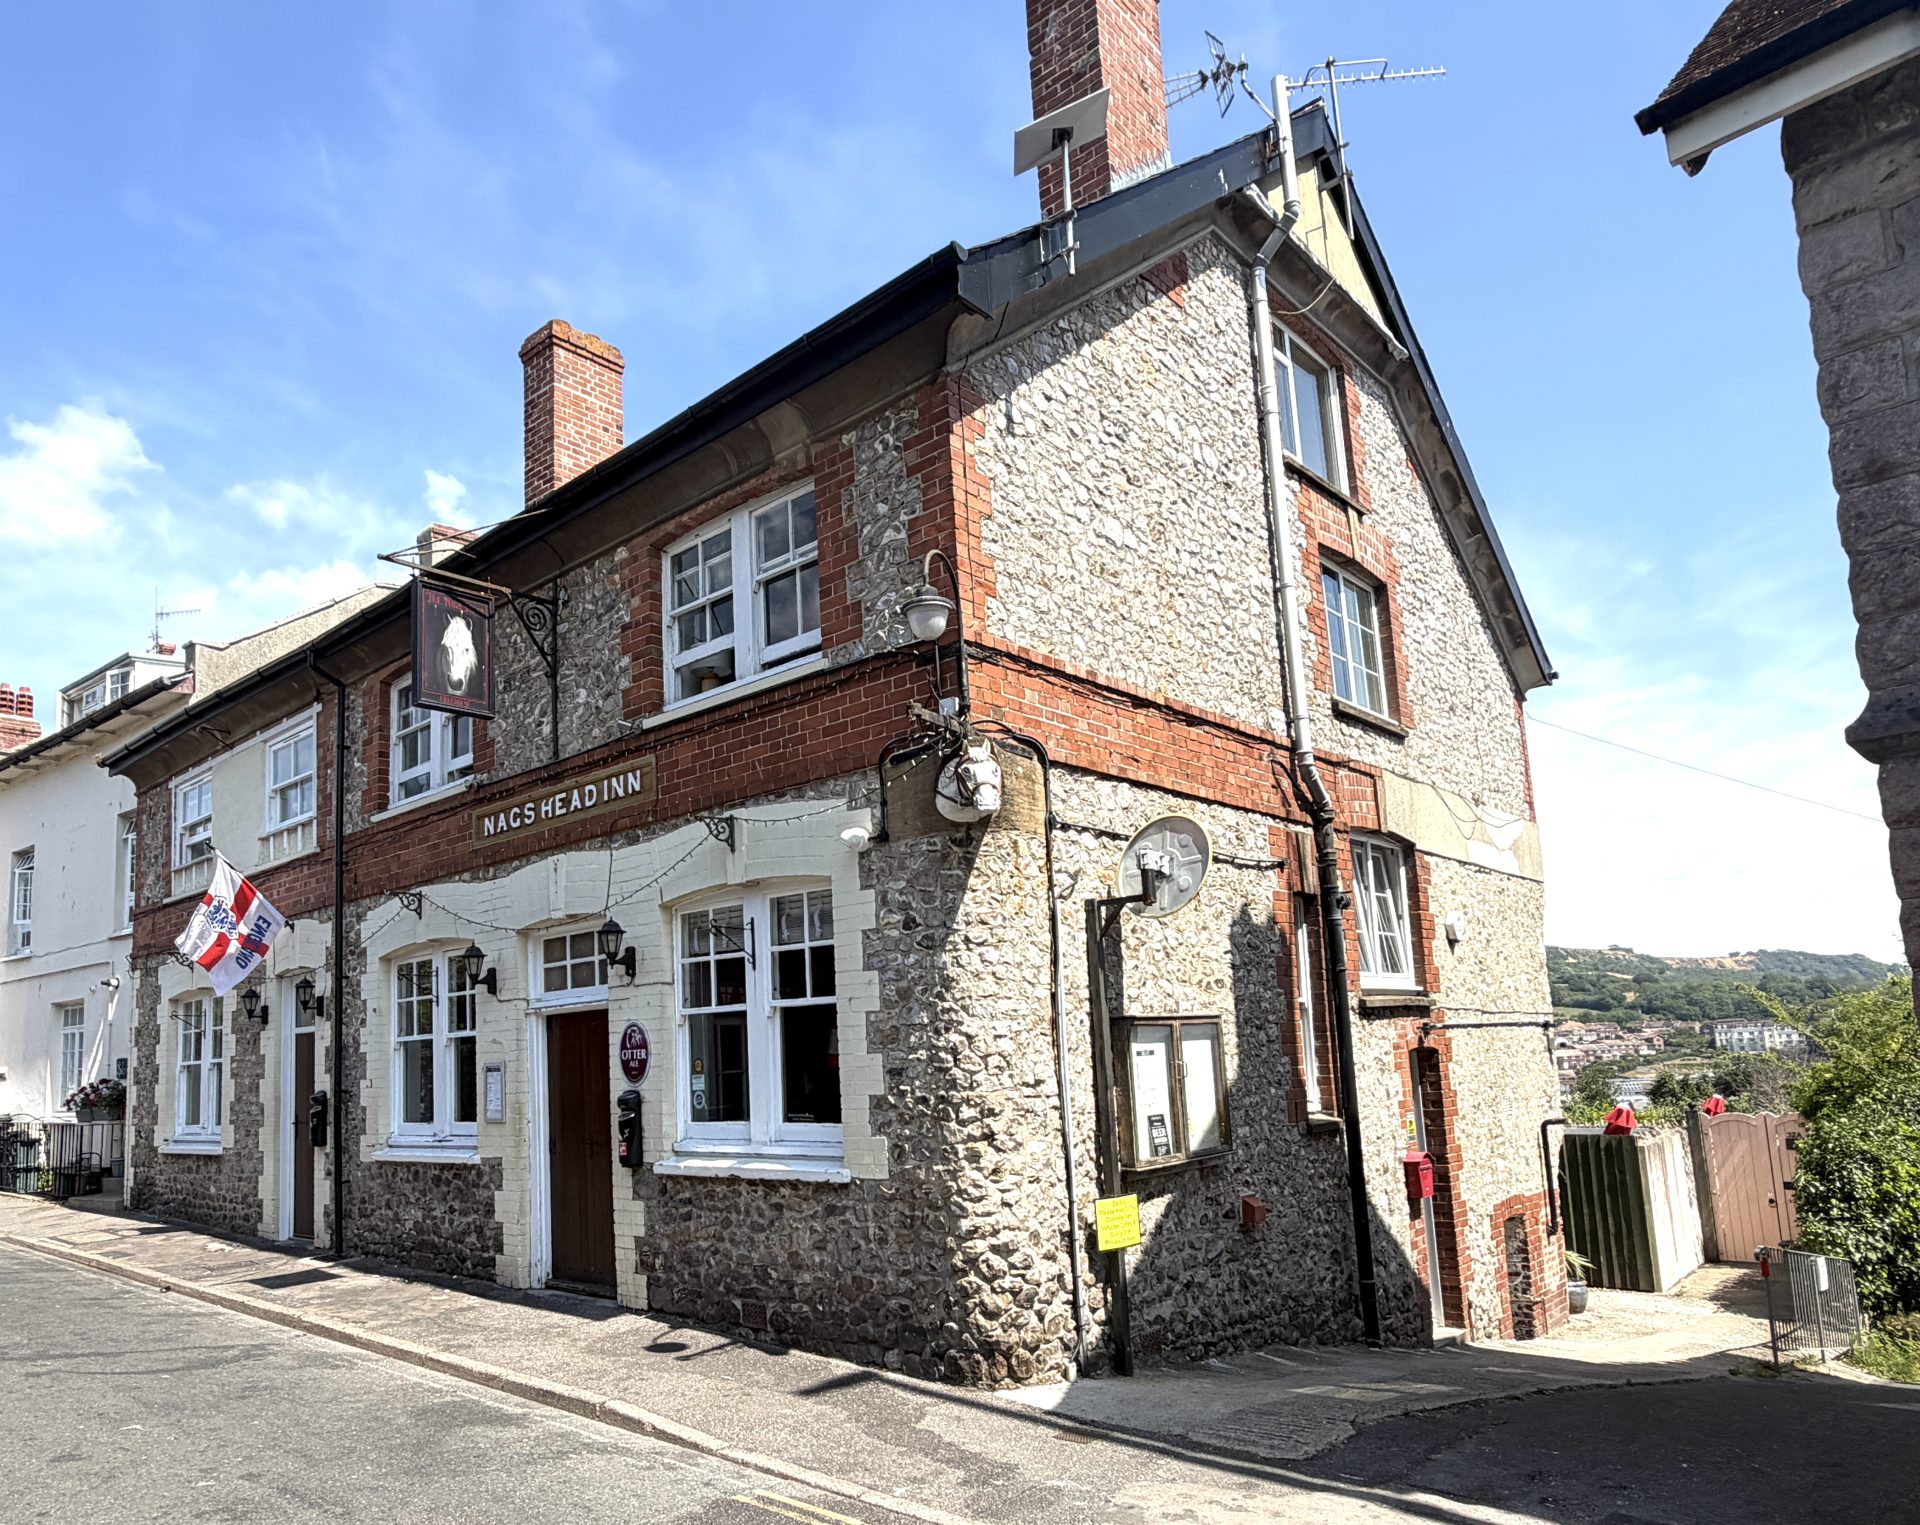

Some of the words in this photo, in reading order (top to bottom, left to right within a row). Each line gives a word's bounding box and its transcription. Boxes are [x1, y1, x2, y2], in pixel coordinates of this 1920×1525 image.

[484, 802, 536, 837] NAGS
[541, 784, 597, 819] HEAD
[603, 769, 641, 801] INN
[621, 1048, 647, 1060] OTTER
[629, 1060, 640, 1068] ALE
